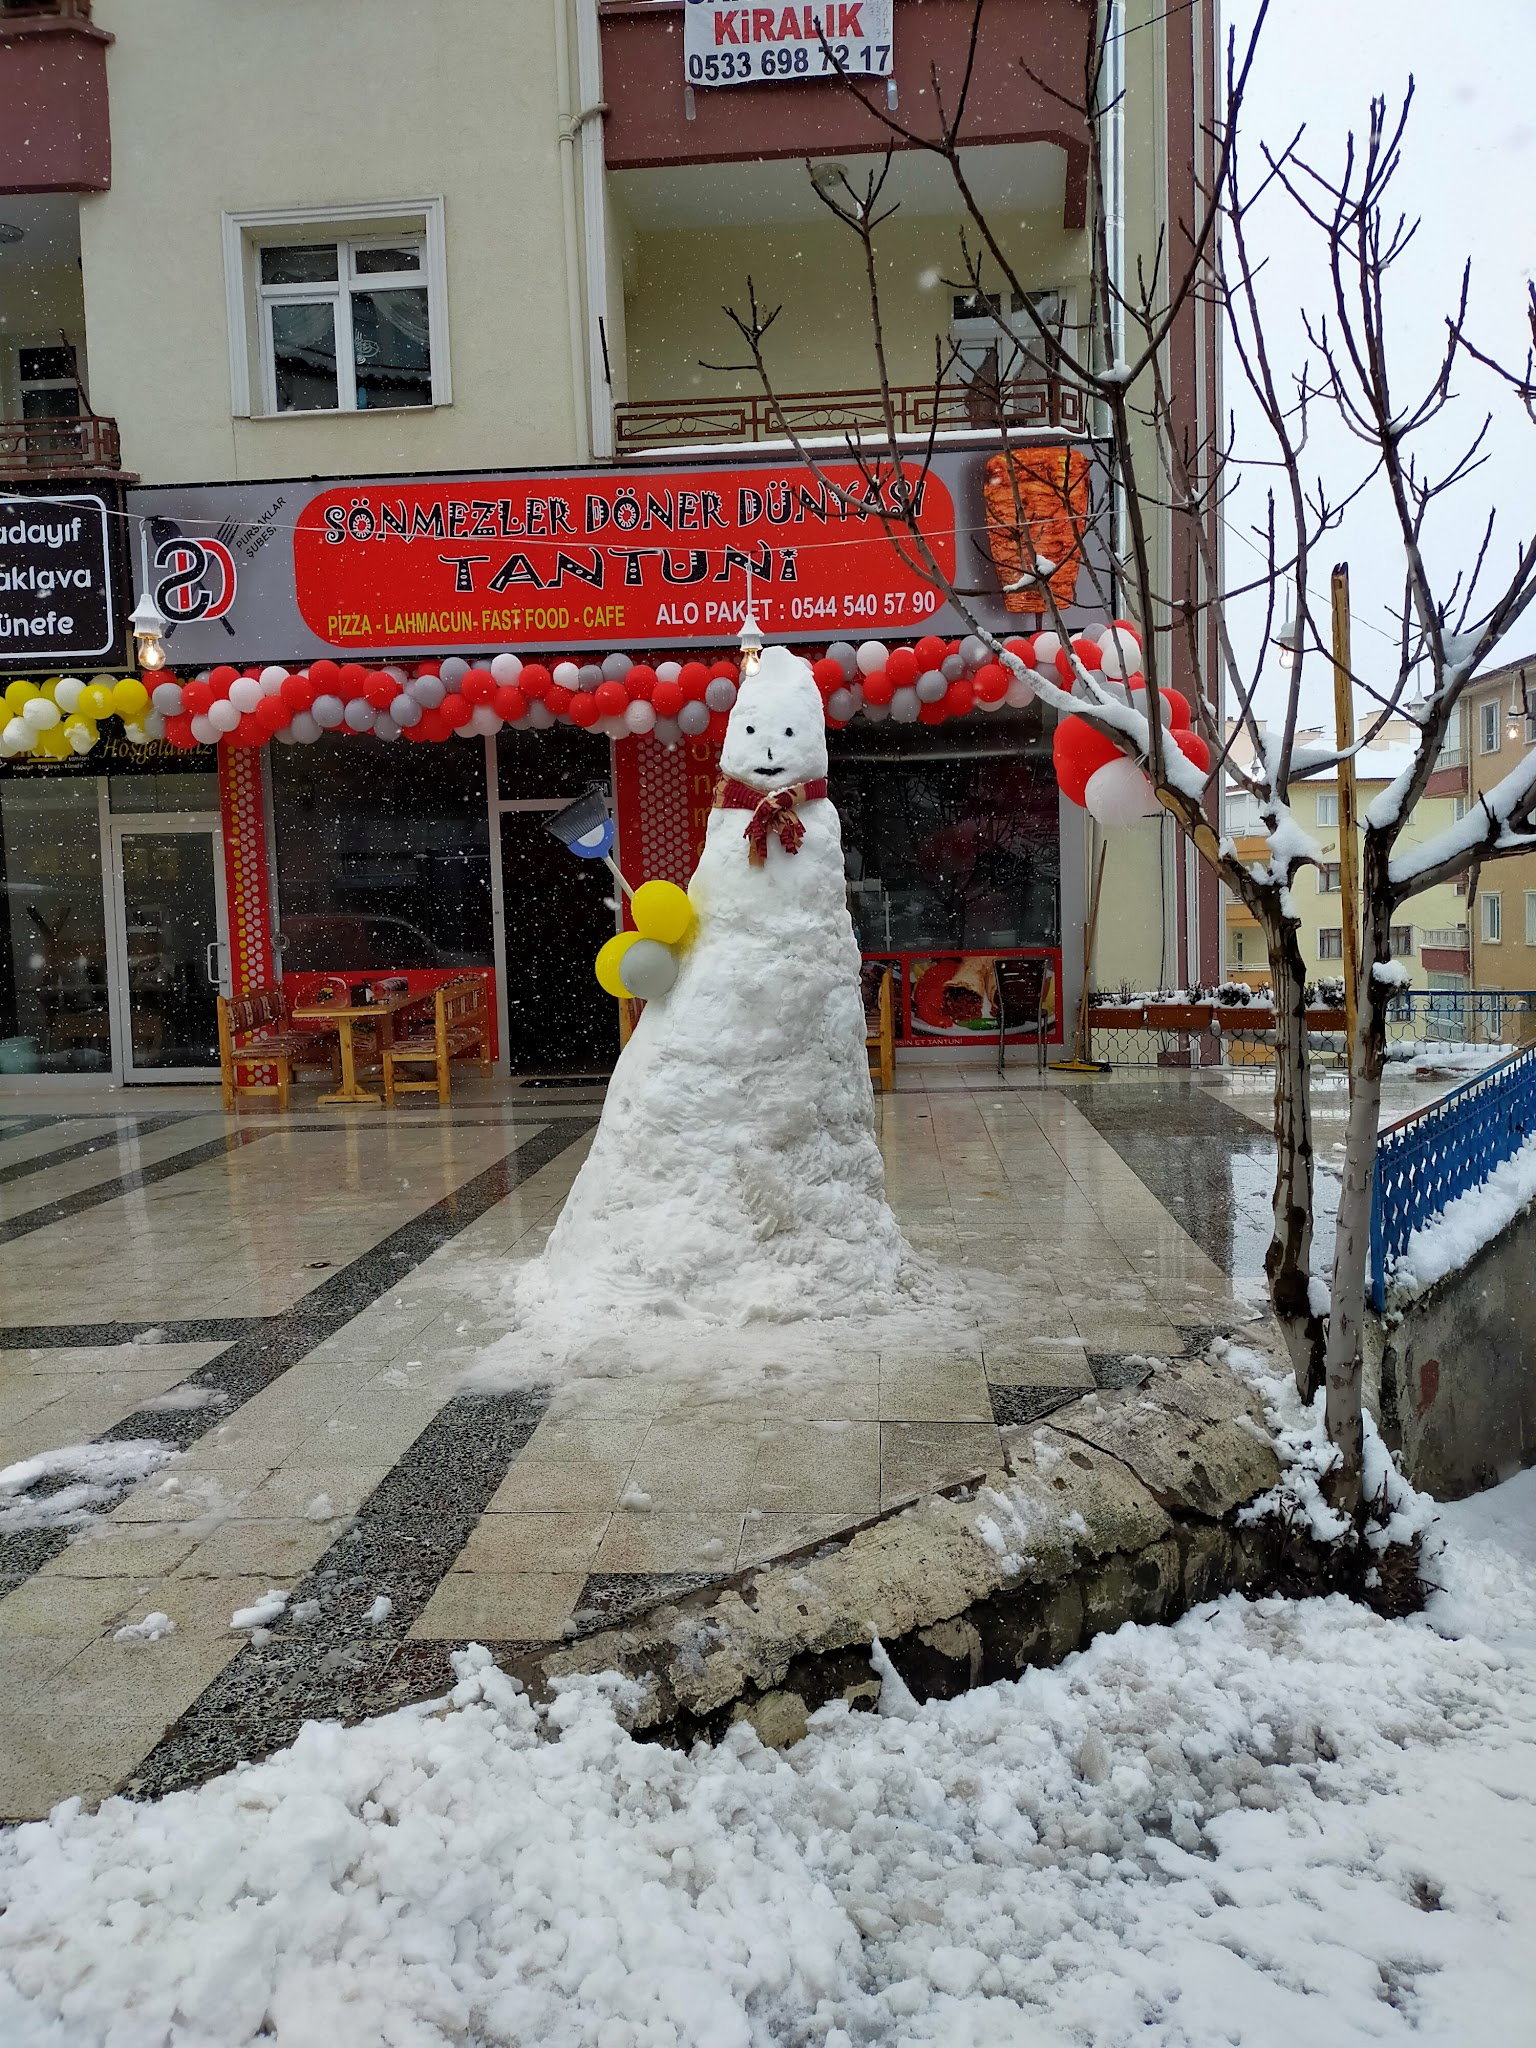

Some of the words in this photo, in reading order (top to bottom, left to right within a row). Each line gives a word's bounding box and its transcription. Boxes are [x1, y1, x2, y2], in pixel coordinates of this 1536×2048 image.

[689, 52, 752, 81] 0533
[761, 47, 809, 76] 698
[818, 44, 850, 71] 72
[860, 44, 891, 72] 17
[235, 496, 287, 551] PURSAKLAR
[324, 496, 578, 545] SÖNMEZLER
[586, 487, 729, 532] DÖNER
[738, 480, 927, 525] DÜNYASI
[328, 609, 373, 637] PİZZA
[482, 609, 521, 632] FAST
[525, 607, 570, 630] FOOD
[583, 605, 626, 628] CAFE
[655, 601, 700, 626] ALO
[705, 598, 774, 624] PAKET
[791, 595, 838, 620] 0544
[842, 593, 878, 617] 540
[883, 592, 907, 615] 57
[912, 590, 936, 614] 90
